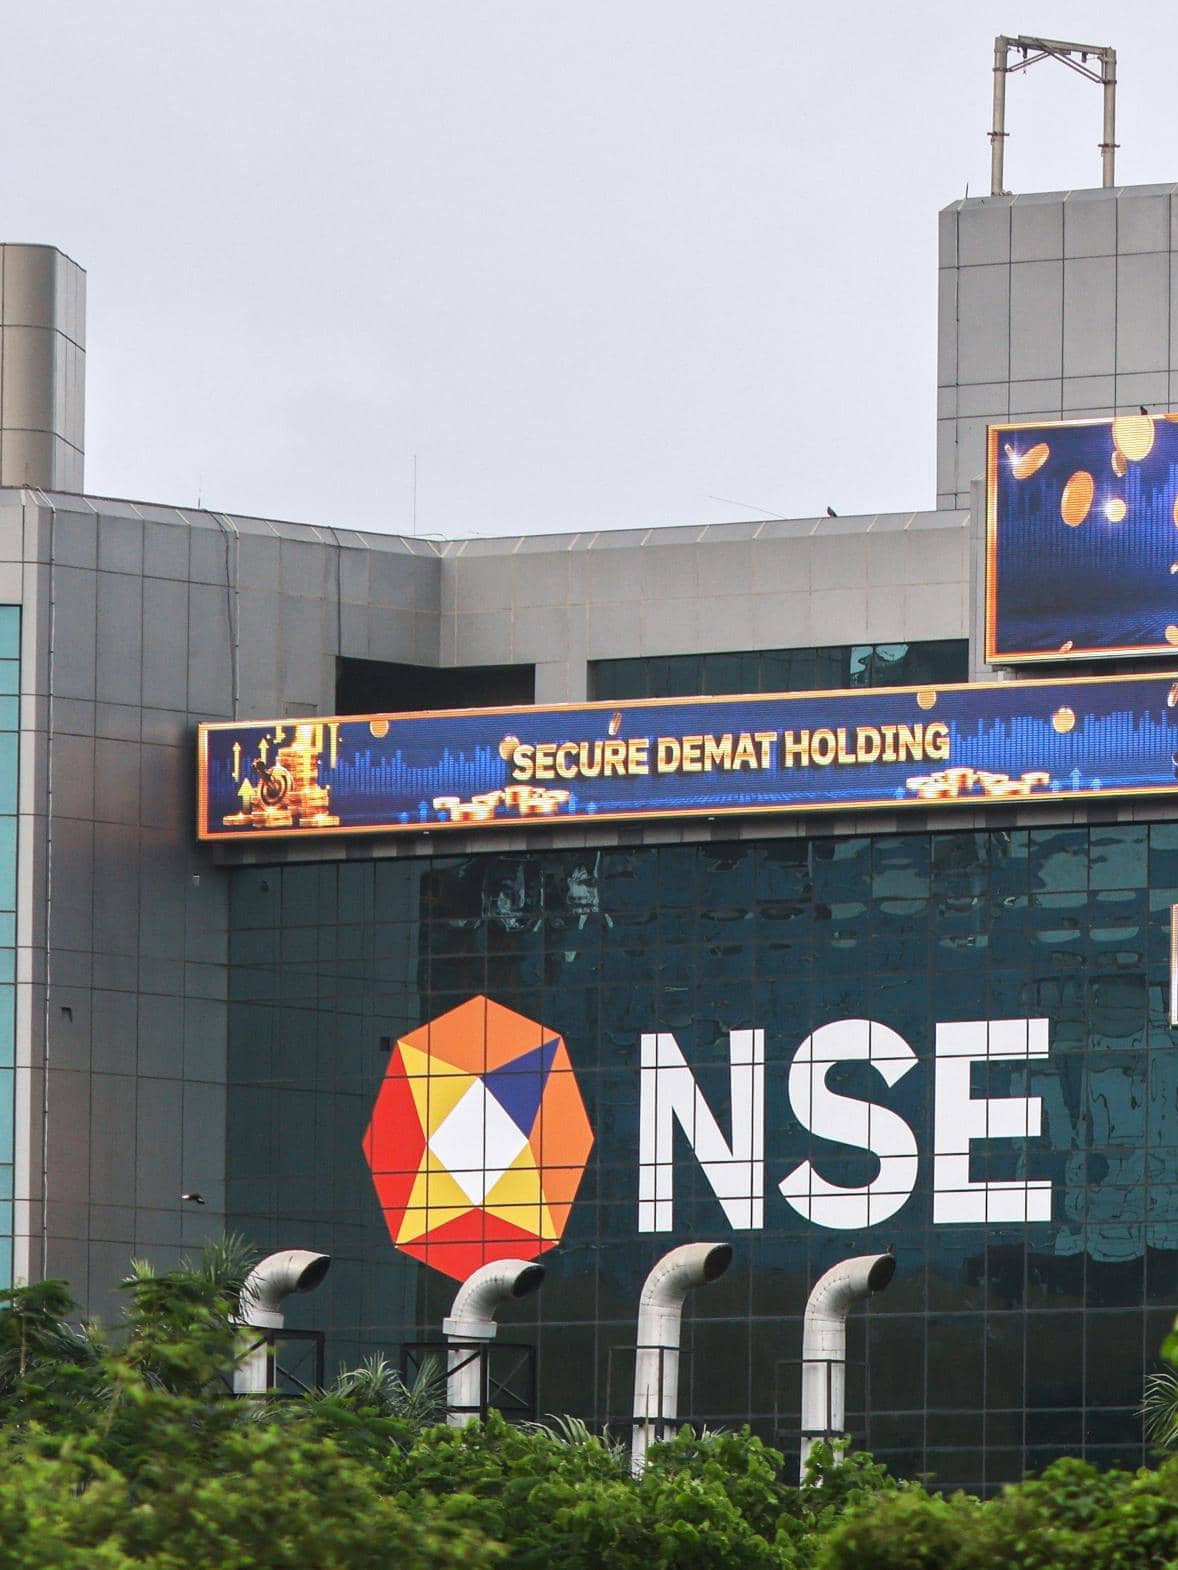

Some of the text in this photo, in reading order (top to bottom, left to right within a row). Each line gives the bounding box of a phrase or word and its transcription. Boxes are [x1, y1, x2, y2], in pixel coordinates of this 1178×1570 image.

[511, 722, 950, 781] SECURE DEMAT HOLDING
[638, 1018, 1052, 1232] NSE
